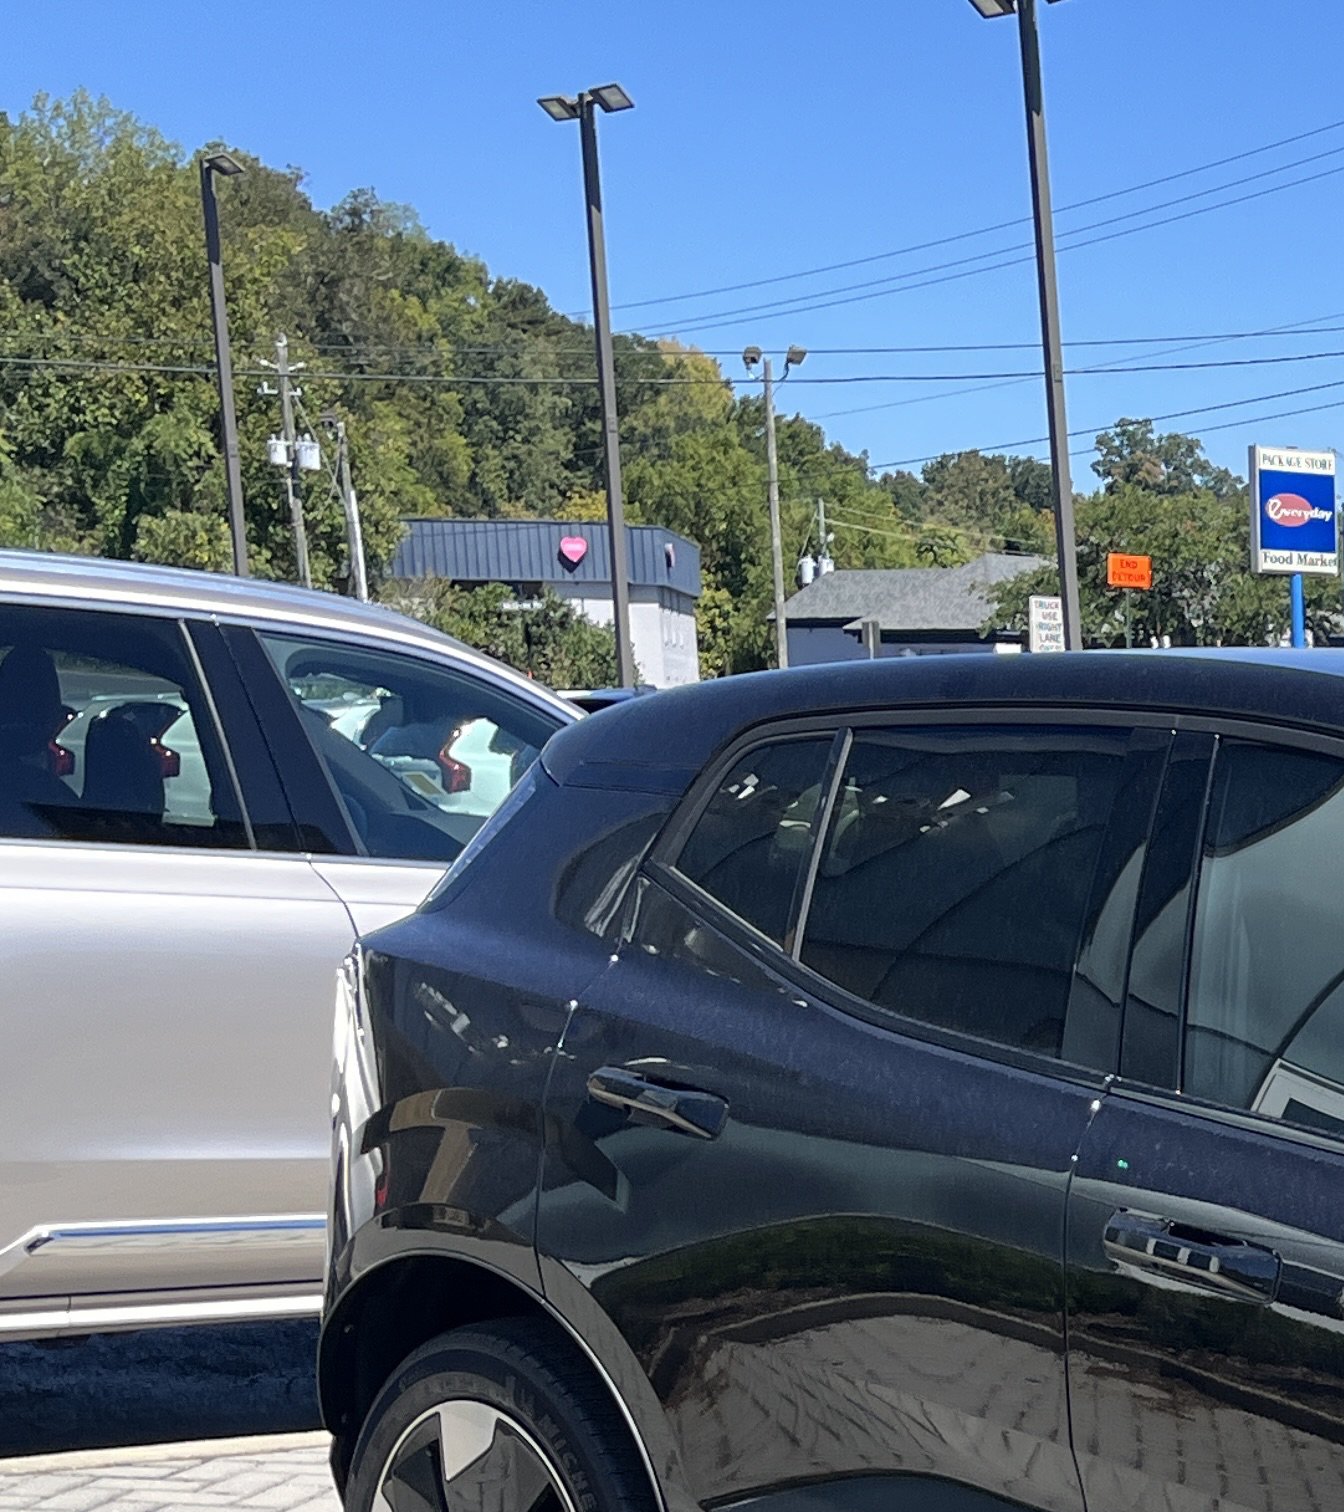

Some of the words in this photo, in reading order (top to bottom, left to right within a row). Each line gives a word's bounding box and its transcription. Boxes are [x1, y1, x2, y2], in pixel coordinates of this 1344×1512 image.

[1262, 453, 1301, 468] PACKAGE
[1305, 457, 1332, 470] STORE
[1120, 559, 1138, 569] END
[1263, 551, 1293, 565] Food
[1112, 570, 1146, 582] DETOUR
